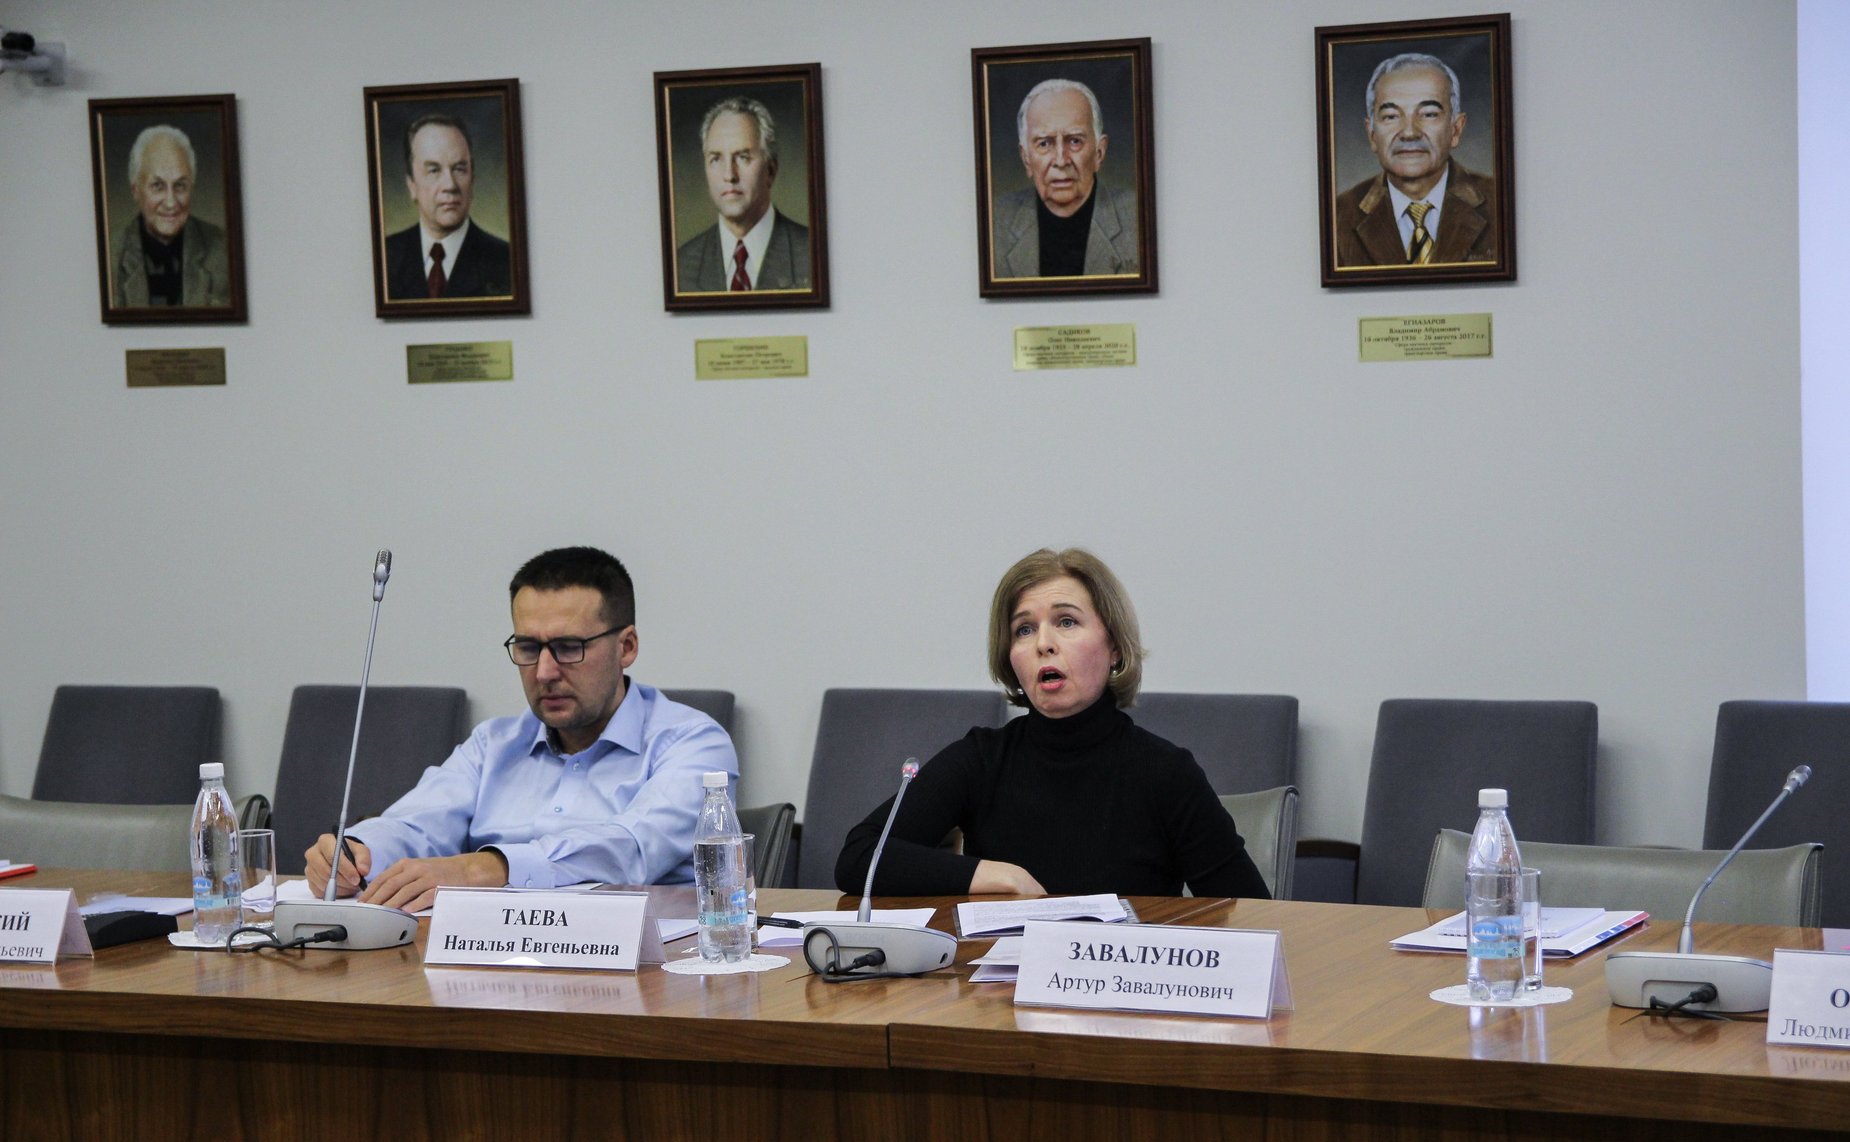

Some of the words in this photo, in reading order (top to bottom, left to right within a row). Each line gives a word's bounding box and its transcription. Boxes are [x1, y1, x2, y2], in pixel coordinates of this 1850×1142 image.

[0, 911, 31, 931] ИЙ
[502, 907, 569, 927] ТАЕВА
[0, 945, 43, 958] ьевич
[444, 934, 515, 953] Наталья
[521, 937, 620, 956] Евгеньевна
[1067, 941, 1221, 969] ЗАВАЛУНОВ
[1046, 971, 1106, 995] Артур
[1111, 975, 1234, 1001] Завалунович
